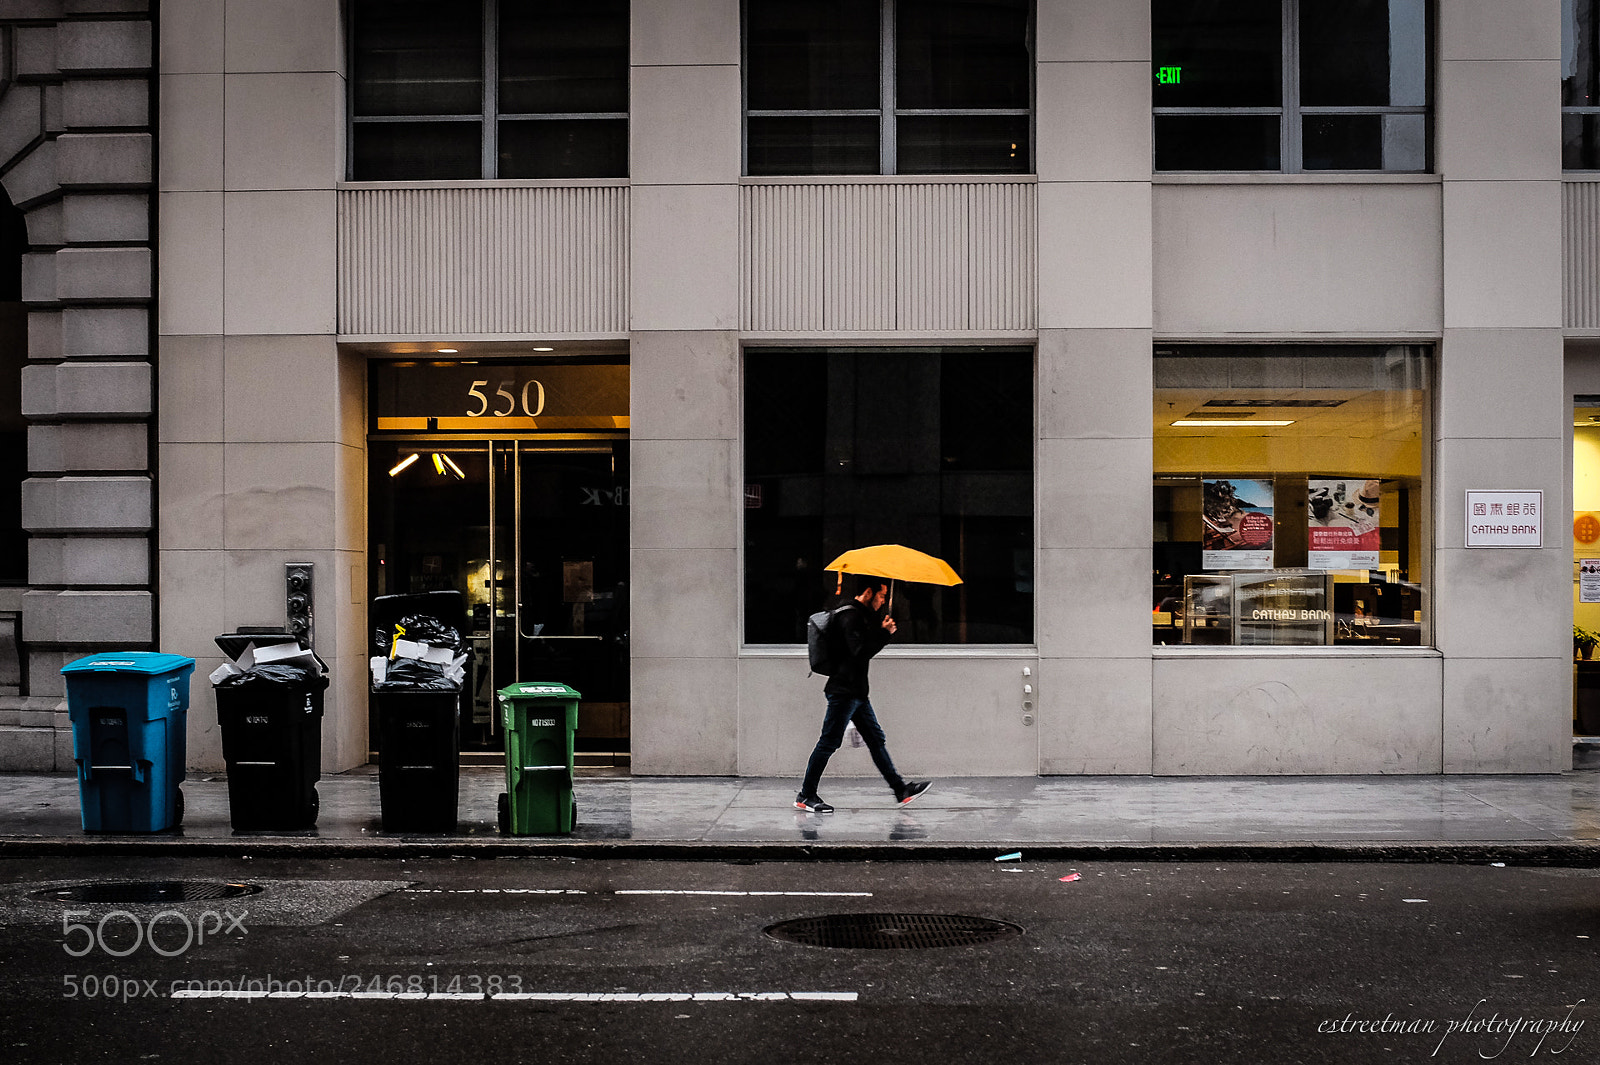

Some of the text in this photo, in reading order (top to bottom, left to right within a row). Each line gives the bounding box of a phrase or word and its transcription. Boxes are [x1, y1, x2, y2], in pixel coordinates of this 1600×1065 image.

[1160, 67, 1182, 84] EXIT
[466, 380, 545, 417] 550
[1472, 525, 1537, 535] CATHAY BANK
[1253, 609, 1331, 620] CATHAY BANK
